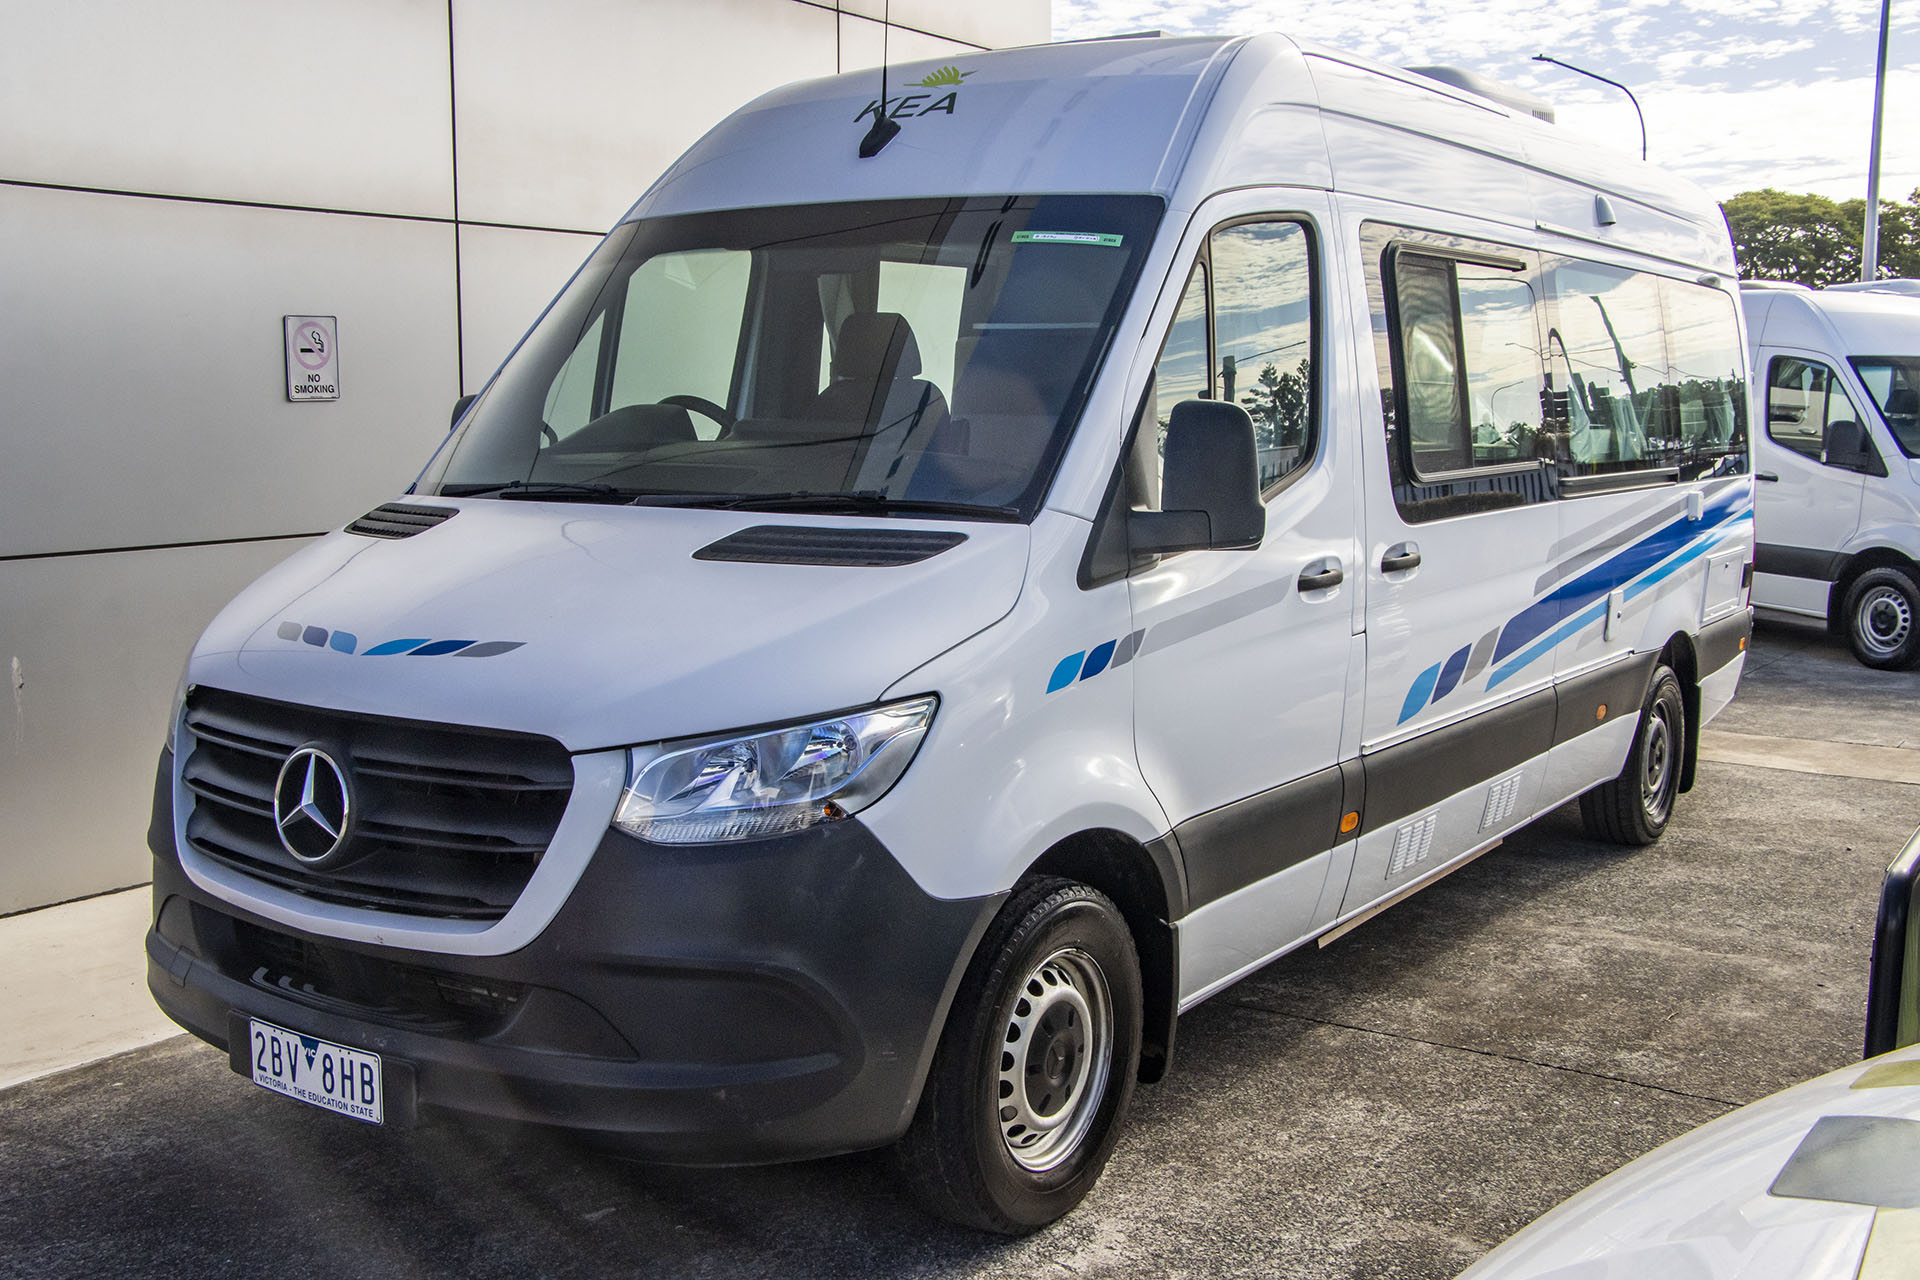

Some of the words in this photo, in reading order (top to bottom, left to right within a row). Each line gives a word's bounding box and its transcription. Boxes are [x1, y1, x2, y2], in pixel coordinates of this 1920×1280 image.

[853, 92, 957, 123] KEA
[294, 385, 335, 393] SMOKING
[307, 374, 321, 382] NO
[255, 1031, 298, 1083] 2BV
[322, 1053, 375, 1105] 8HB
[258, 1074, 287, 1092] VICTORIA
[293, 1087, 306, 1098] THE
[308, 1091, 349, 1111] EDUCATION
[350, 1104, 374, 1118] STATE
